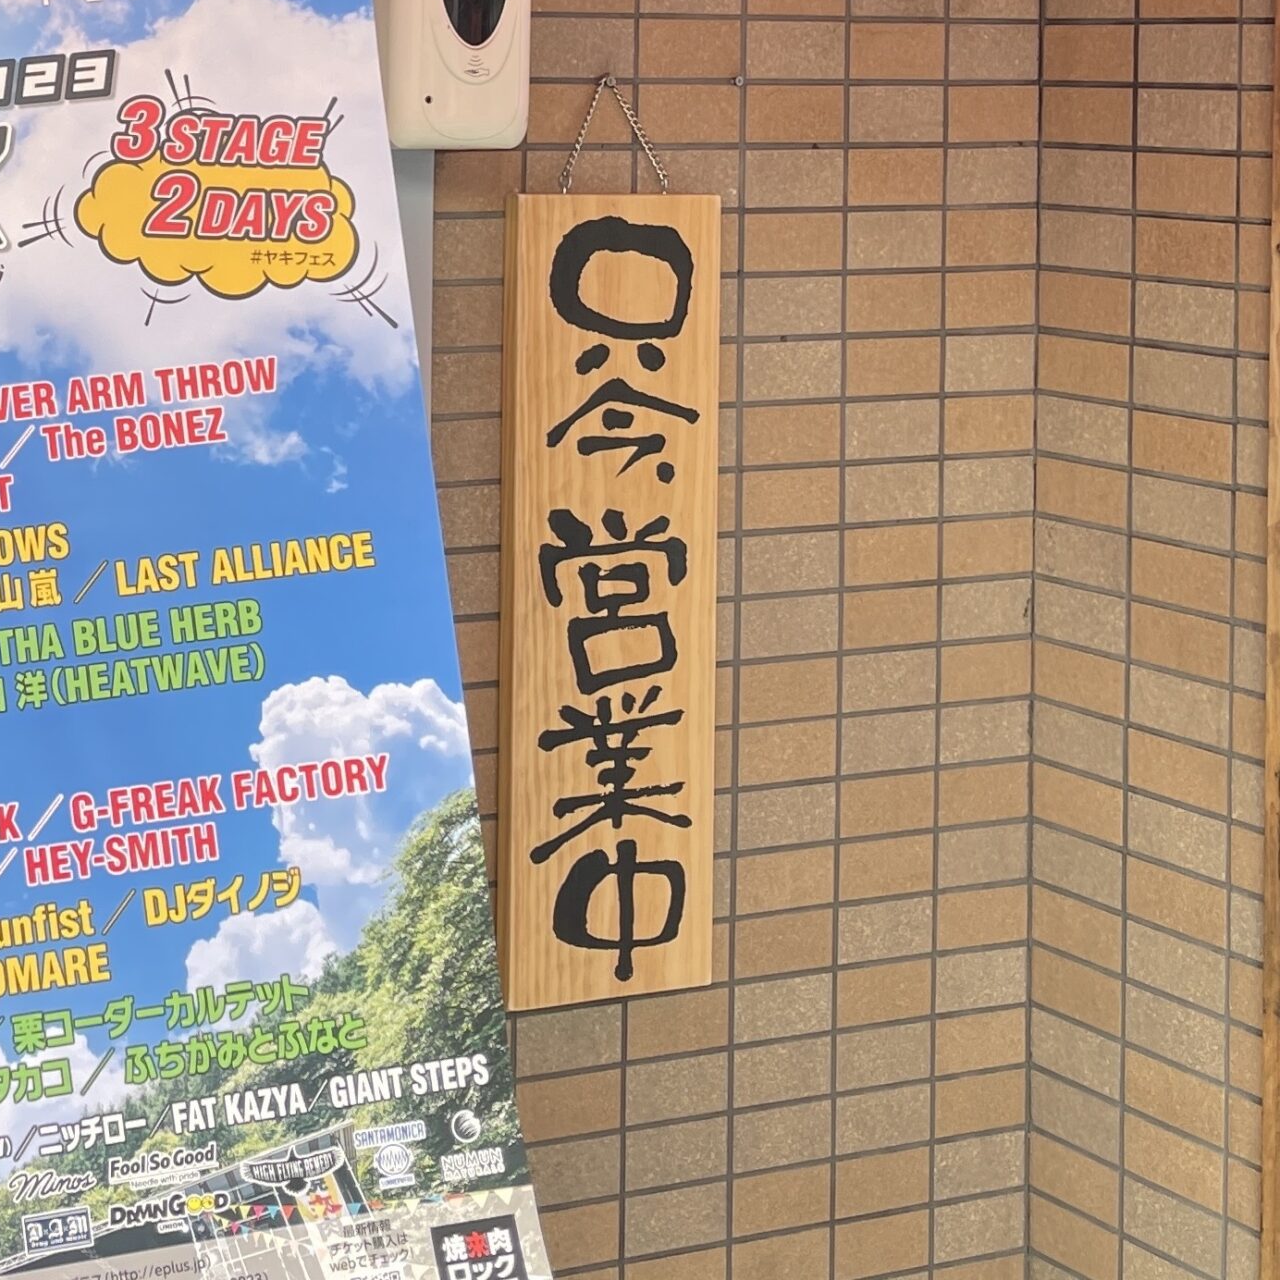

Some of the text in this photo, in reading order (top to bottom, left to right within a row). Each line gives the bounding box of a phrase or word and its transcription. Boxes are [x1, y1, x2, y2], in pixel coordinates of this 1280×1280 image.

[112, 96, 325, 166] 3 STAGE
[145, 172, 336, 241] 2 DAYS
[68, 372, 145, 413] ARM
[155, 357, 278, 401] THROW
[43, 422, 106, 461] The
[116, 407, 227, 452] BONEZ
[115, 552, 200, 596] LAST
[211, 532, 376, 585] ALLIANCE
[72, 611, 161, 657] BLUE
[170, 599, 263, 644] HERB
[70, 775, 225, 832] G-FREAK
[232, 754, 389, 810] FACTORY
[24, 823, 219, 887] HEY-SMITH
[143, 867, 301, 927] DJダイノジ
[11, 973, 309, 1054] 栗コーダーカルテット
[125, 1012, 369, 1085] ふちがみとふなと
[38, 1111, 148, 1157] ニッチロー
[171, 1094, 219, 1135] FAT
[225, 1082, 308, 1123] KAZYA
[329, 1067, 404, 1109] GIANT
[411, 1054, 491, 1094] STEPS
[355, 1122, 425, 1147] SANTAMONICA
[111, 1145, 214, 1177] Fool So Good
[131, 1176, 159, 1188] Needle
[178, 1170, 200, 1183] pride
[252, 1165, 276, 1182] HIGH
[277, 1160, 304, 1180] FLYING
